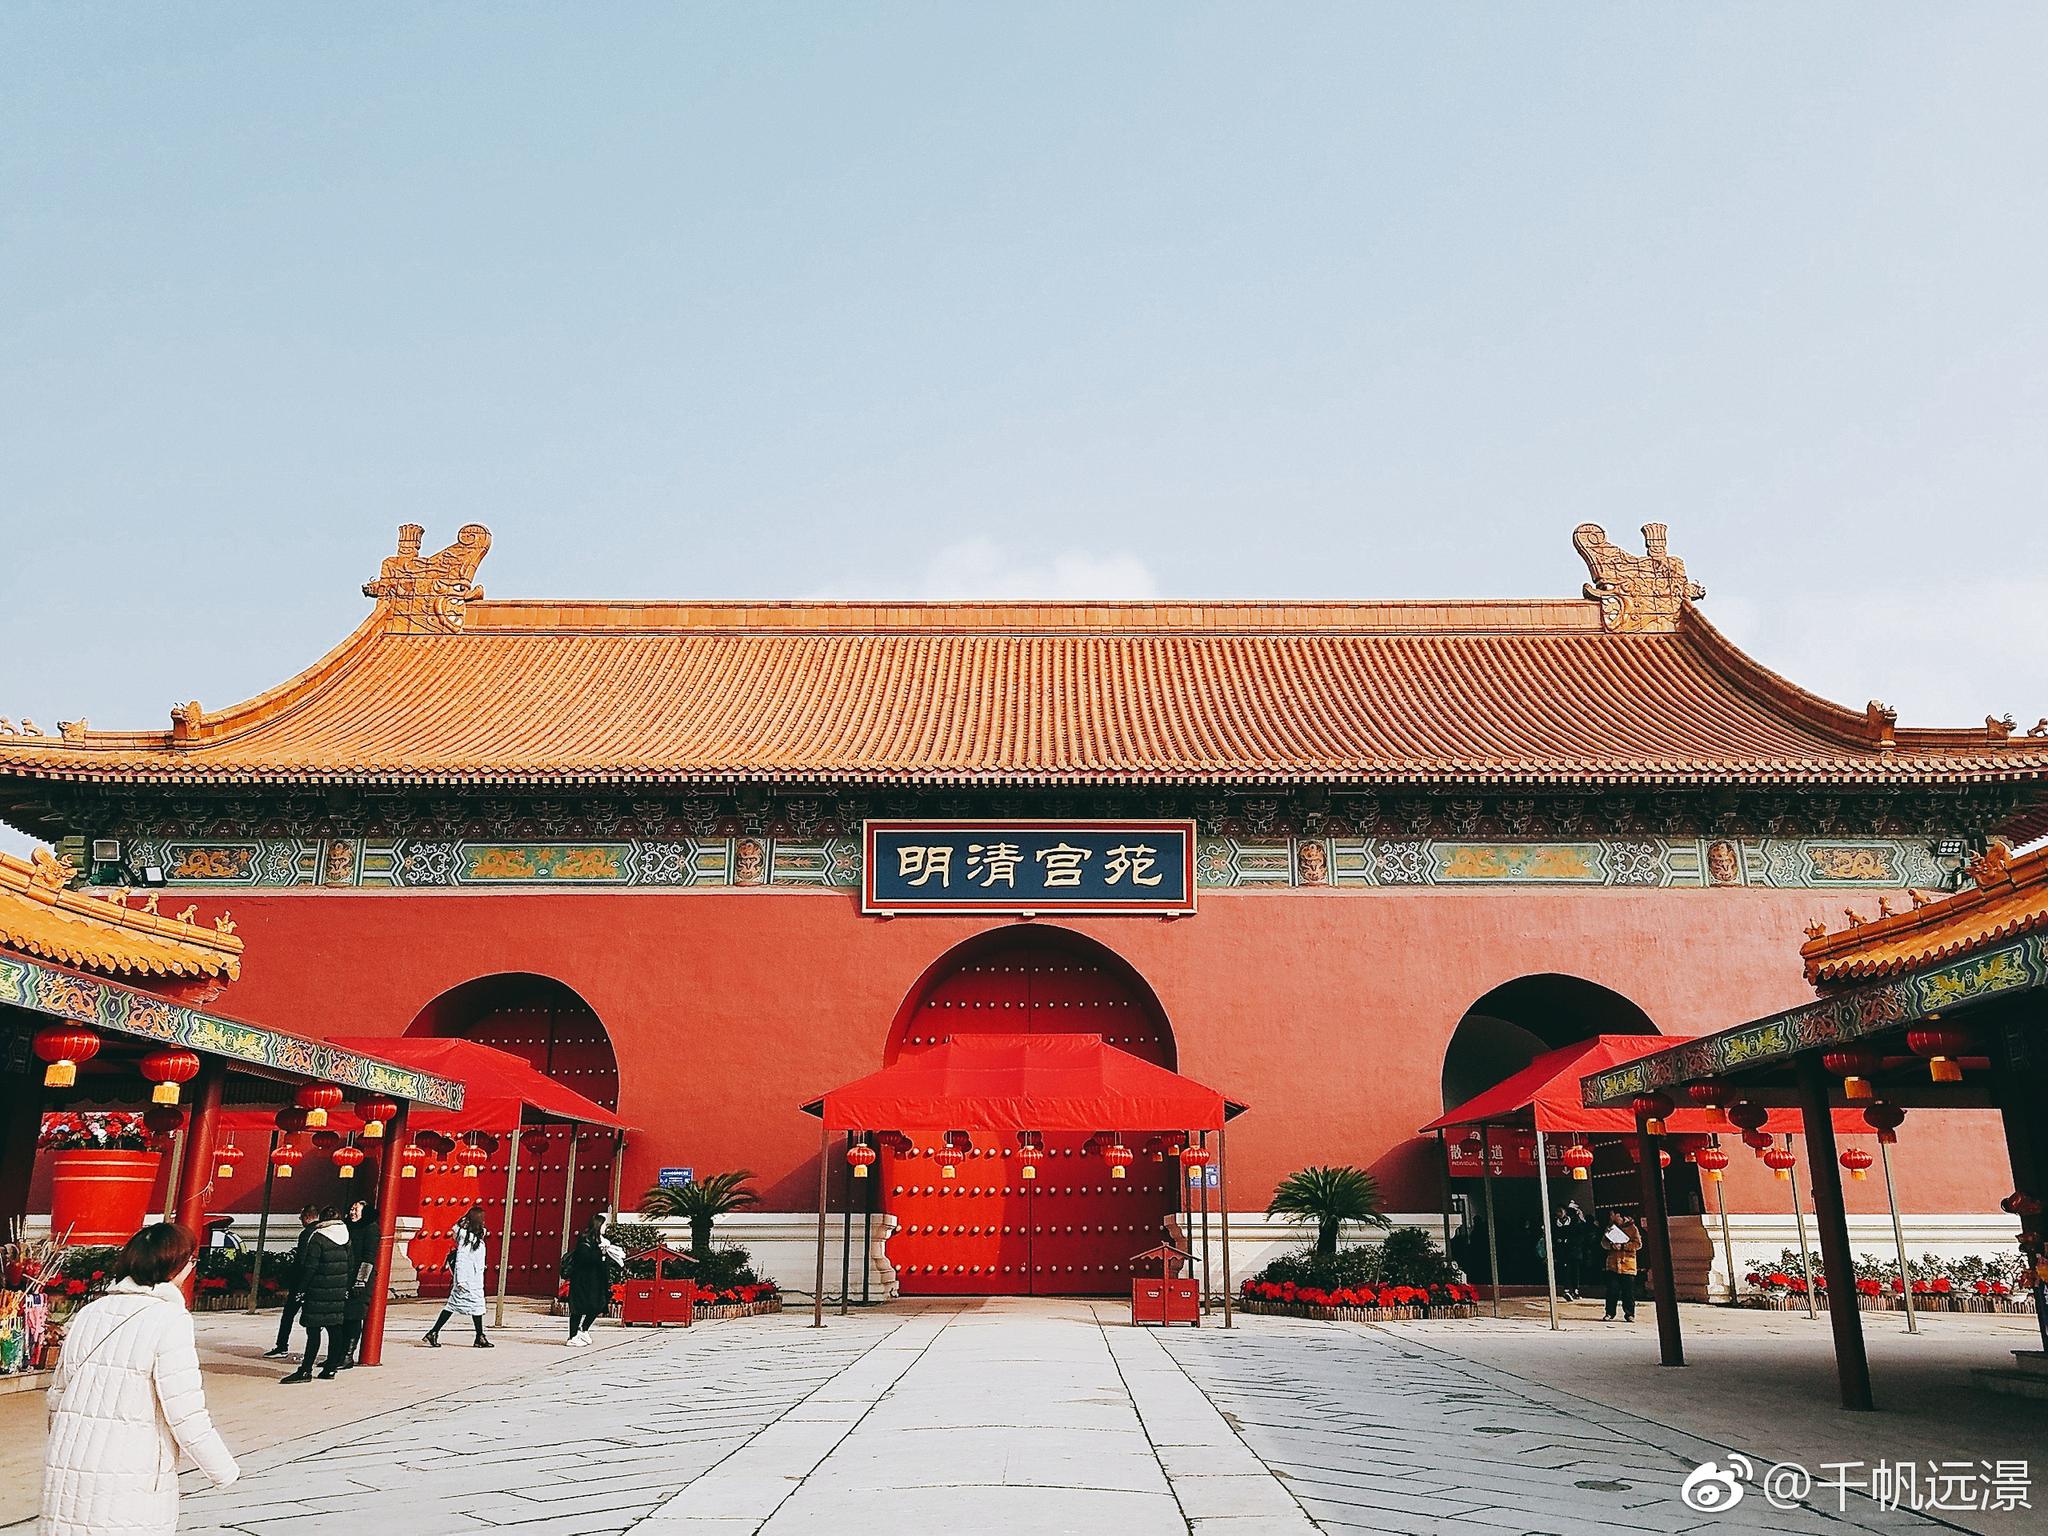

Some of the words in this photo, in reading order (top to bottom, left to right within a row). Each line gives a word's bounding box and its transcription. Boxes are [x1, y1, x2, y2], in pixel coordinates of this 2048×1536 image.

[897, 842, 1163, 889] 明清宫苑
[1450, 1144, 1504, 1160] 散道
